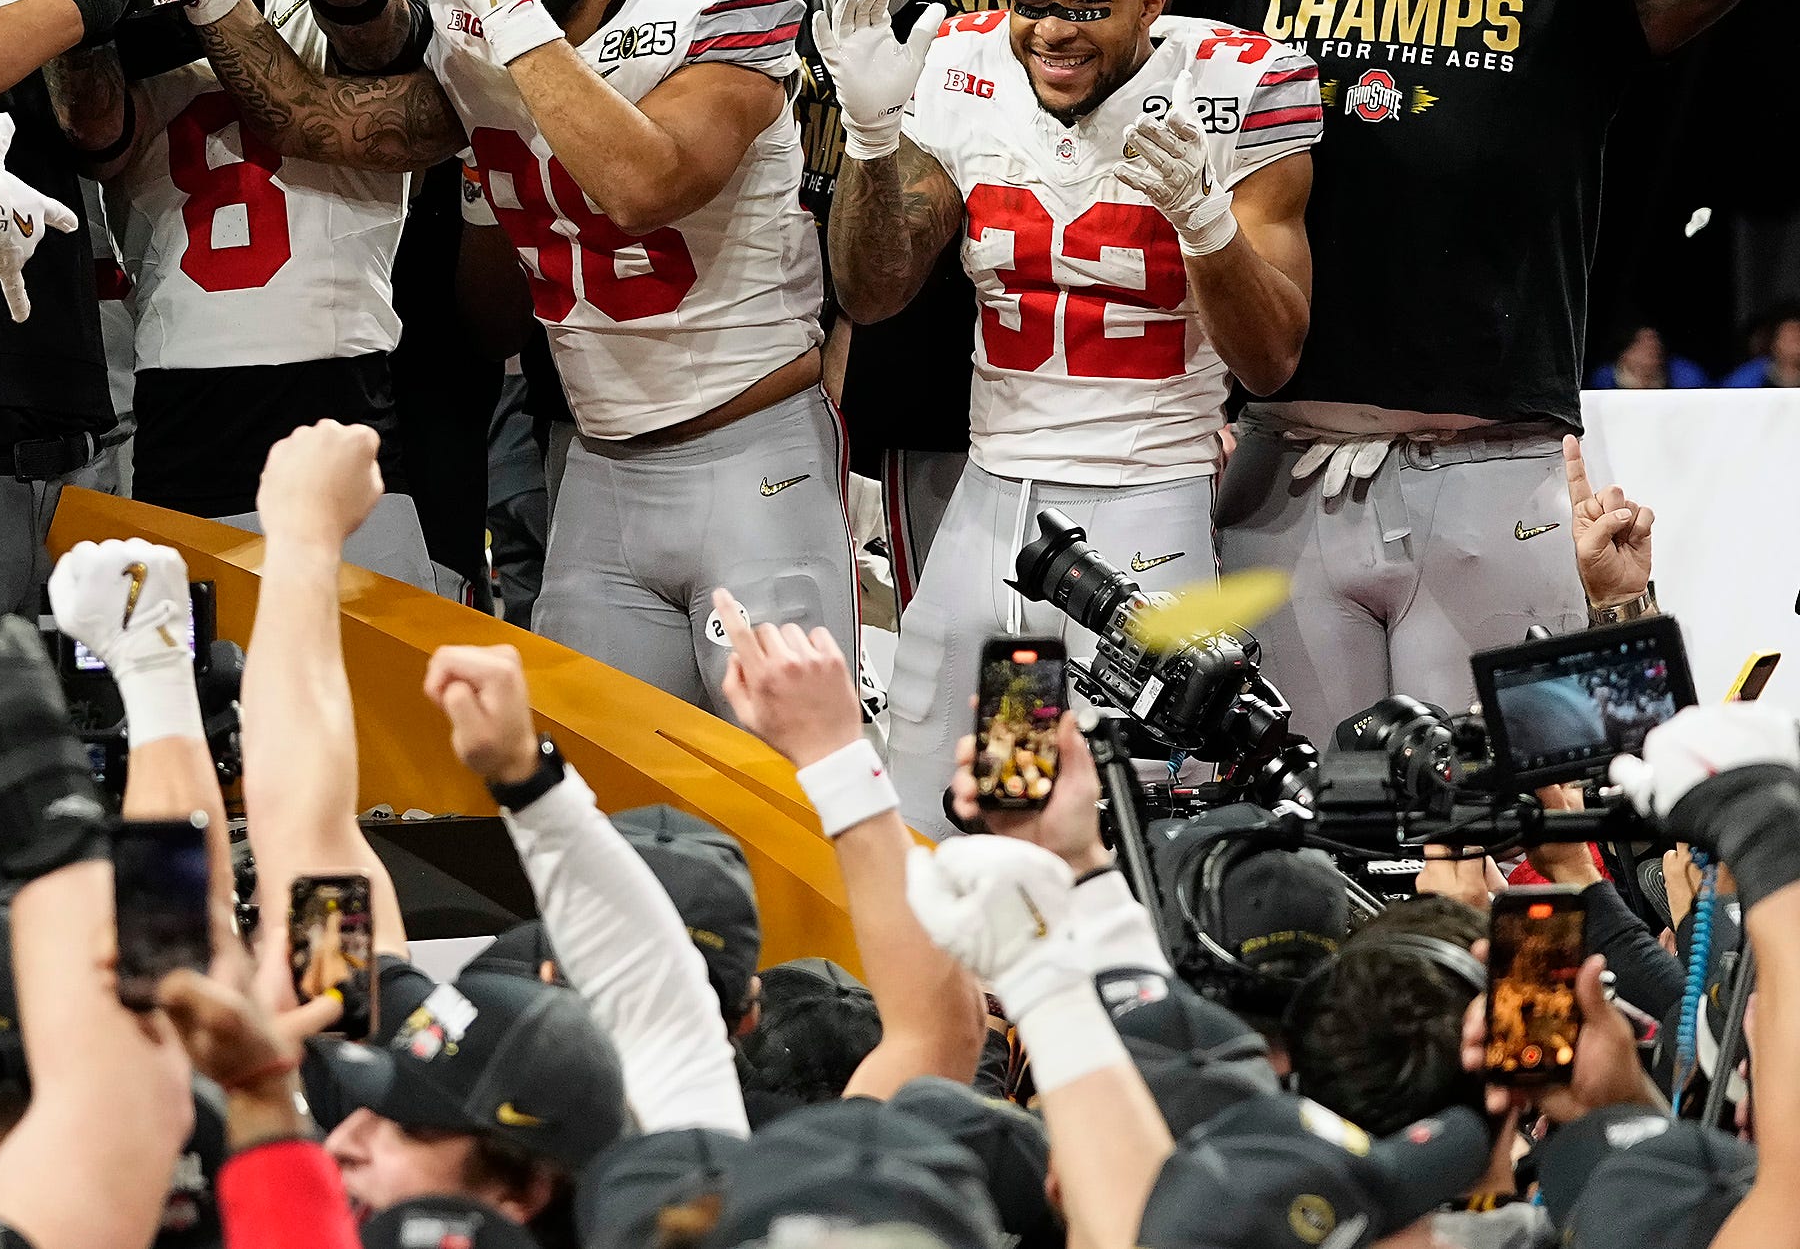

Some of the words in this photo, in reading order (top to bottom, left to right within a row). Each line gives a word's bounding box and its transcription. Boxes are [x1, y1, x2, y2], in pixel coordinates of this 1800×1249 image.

[1067, 9, 1102, 21] 3:22
[1321, 40, 1372, 60] FOR
[1385, 44, 1435, 66] THE
[1446, 50, 1515, 73] AGES
[168, 90, 292, 293] 8
[965, 182, 1188, 379] 32
